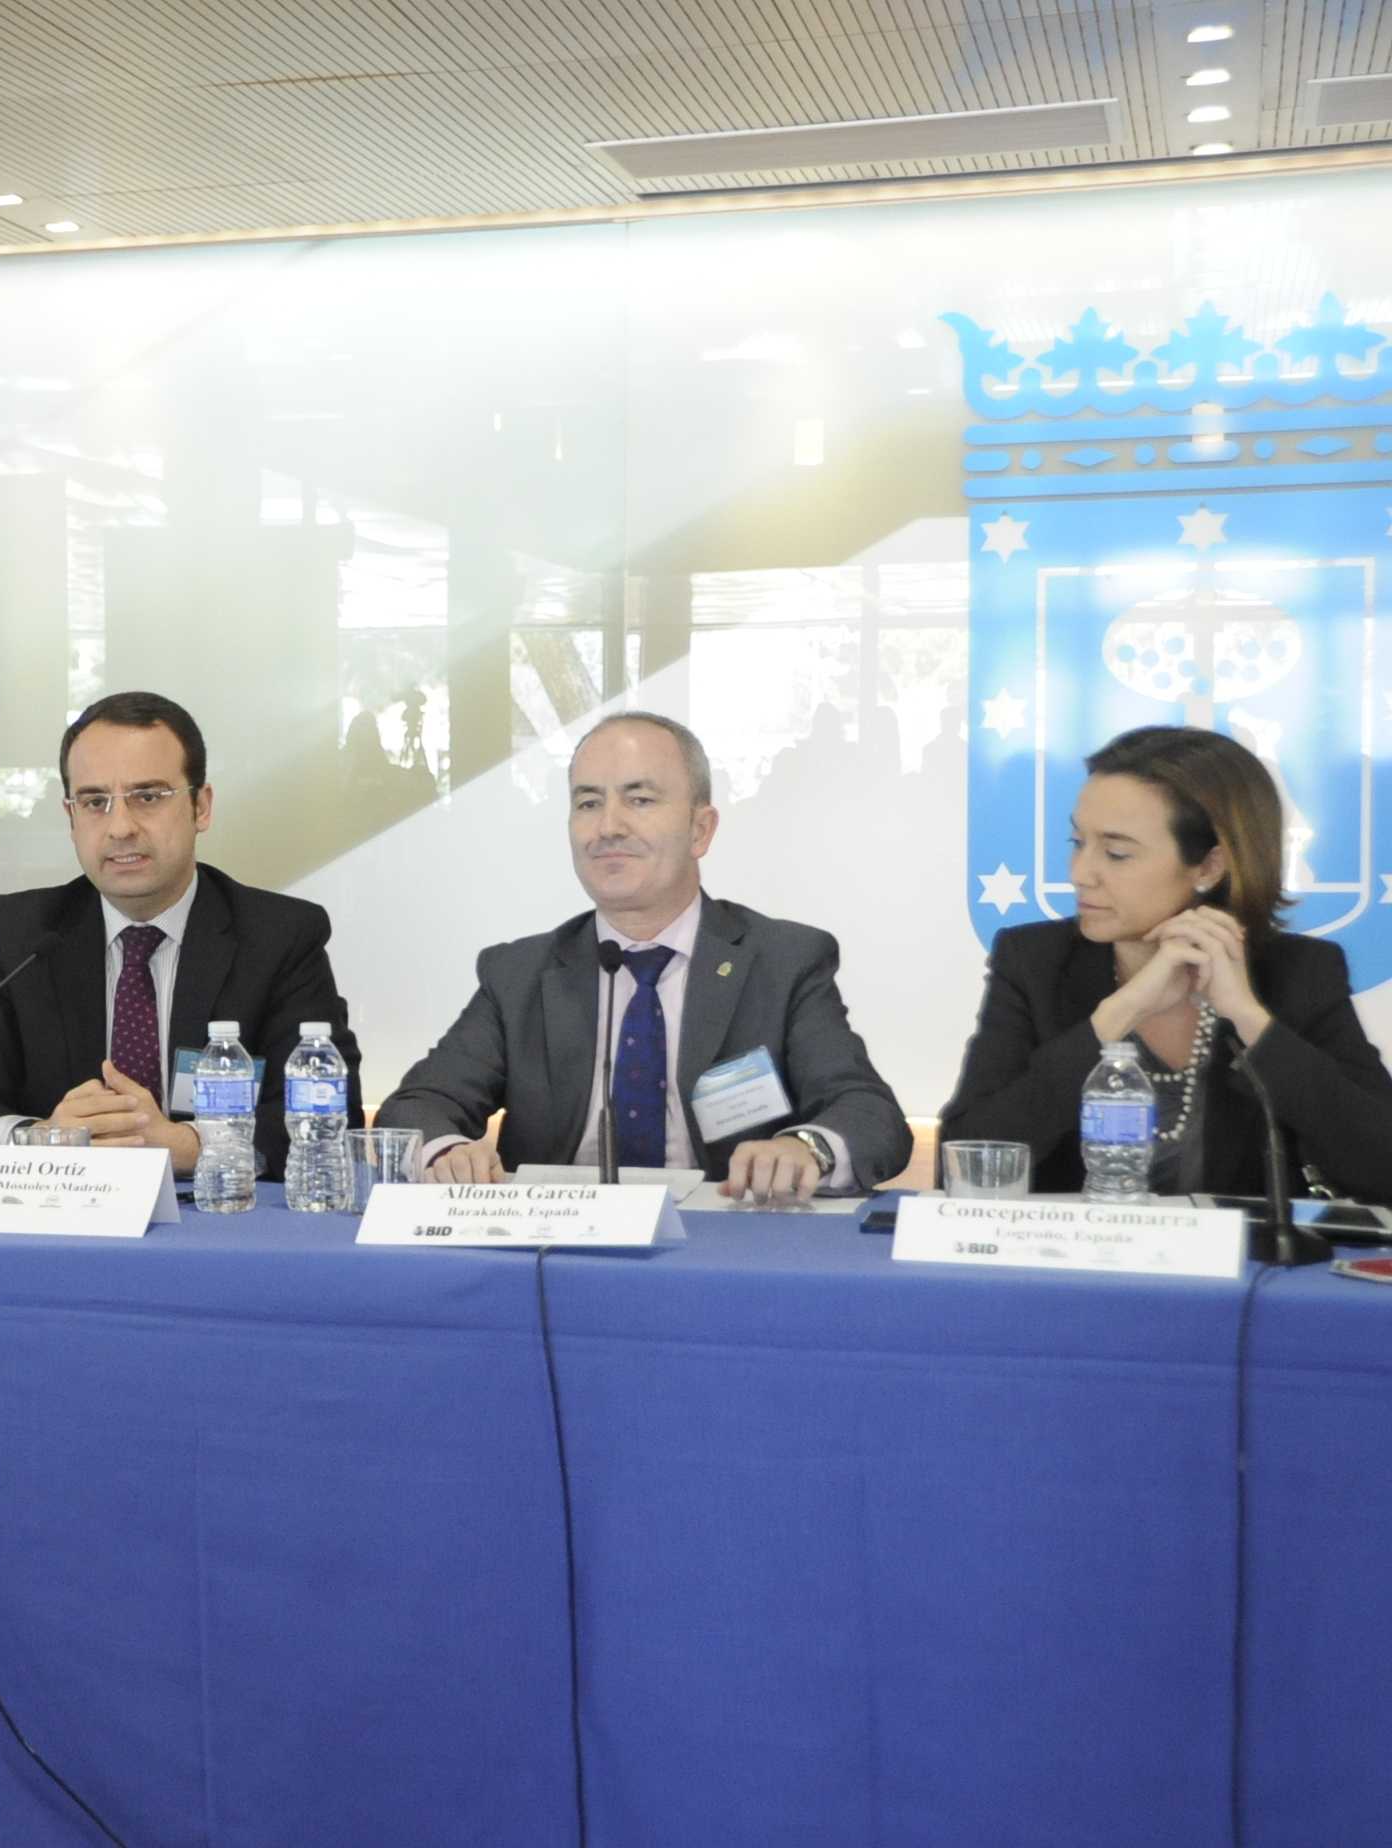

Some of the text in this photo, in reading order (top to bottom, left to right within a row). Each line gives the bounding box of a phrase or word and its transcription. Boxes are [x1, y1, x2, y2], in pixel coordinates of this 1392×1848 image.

[38, 1161, 87, 1176] Ortiz
[440, 1184, 597, 1200] Alfonso García
[937, 1201, 1199, 1227] Concepción Gamarra
[967, 1242, 999, 1255] BID
